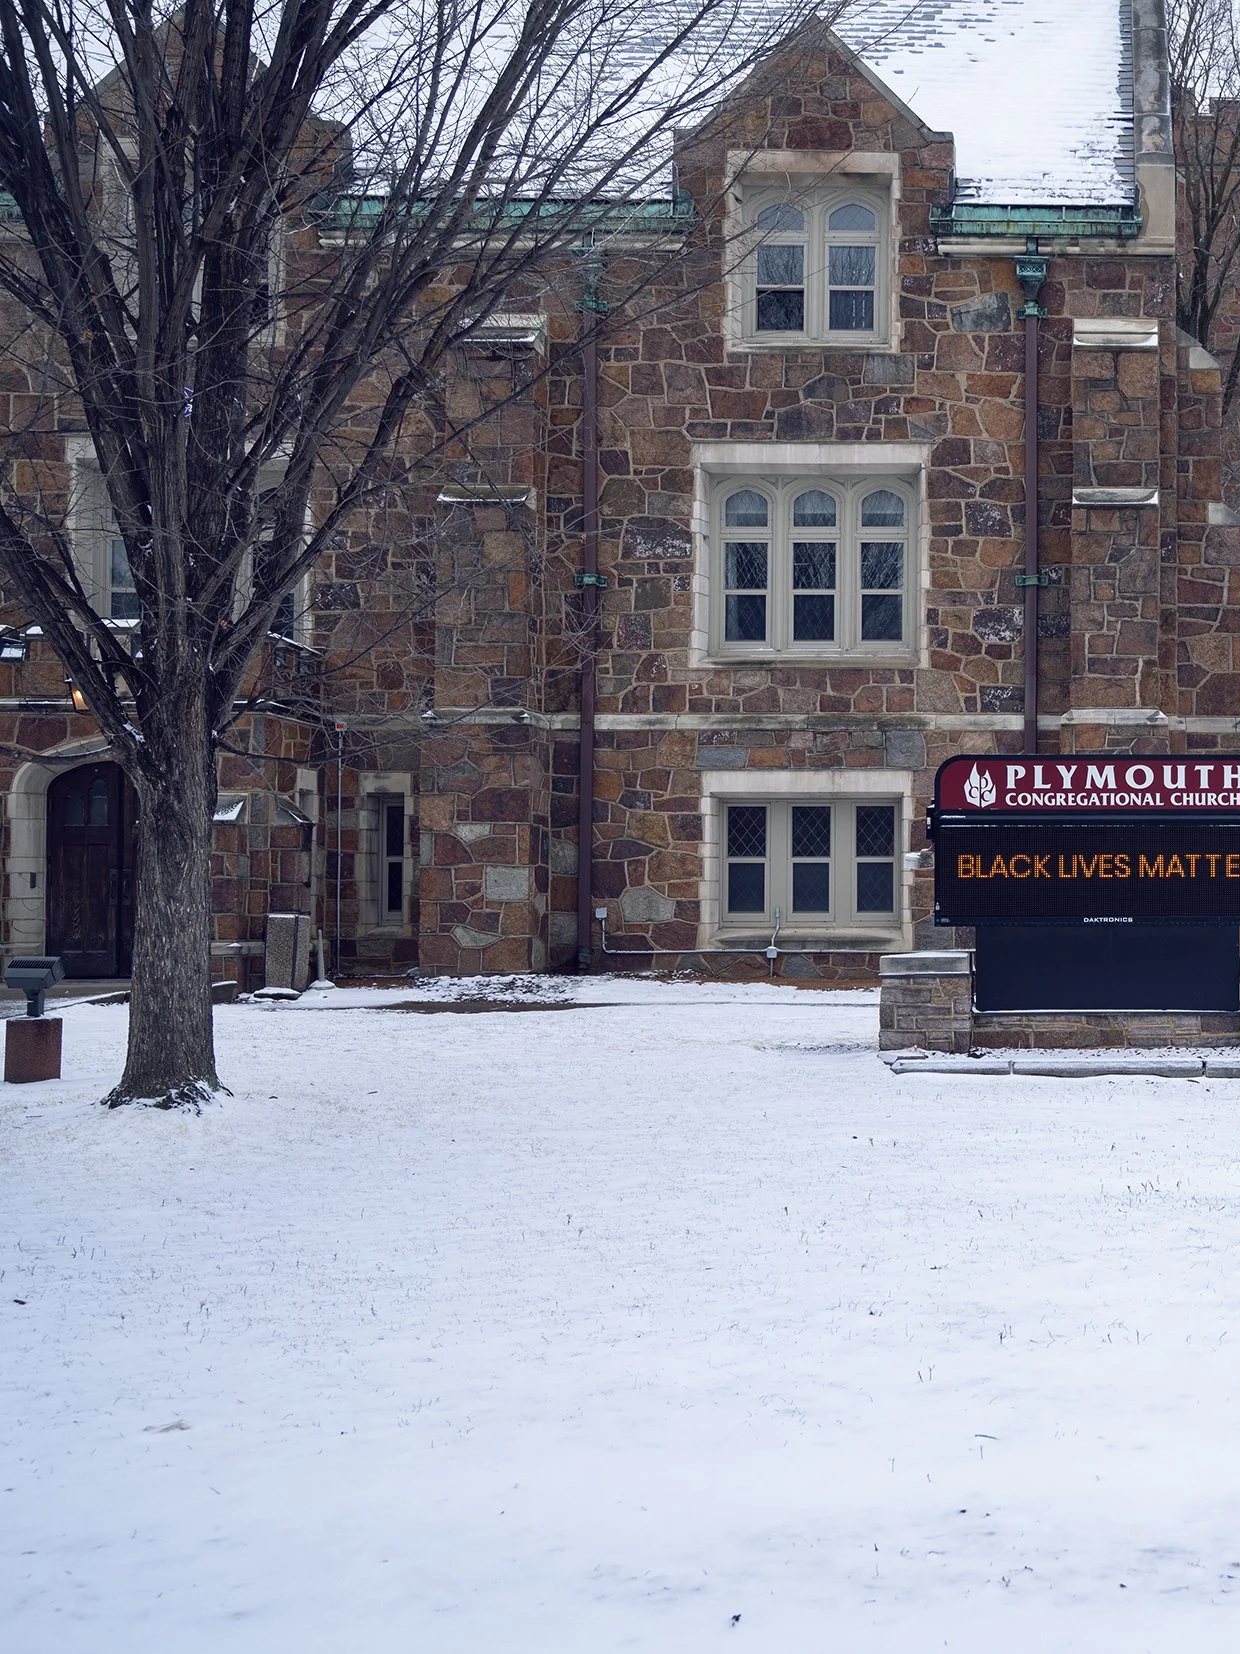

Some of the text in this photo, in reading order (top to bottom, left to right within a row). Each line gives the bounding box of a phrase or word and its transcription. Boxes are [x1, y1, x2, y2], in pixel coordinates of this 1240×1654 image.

[1005, 792, 1240, 807] CONGREGATIONAL CHURCH
[957, 854, 1051, 878] BLACK
[1058, 854, 1131, 878] LIVES
